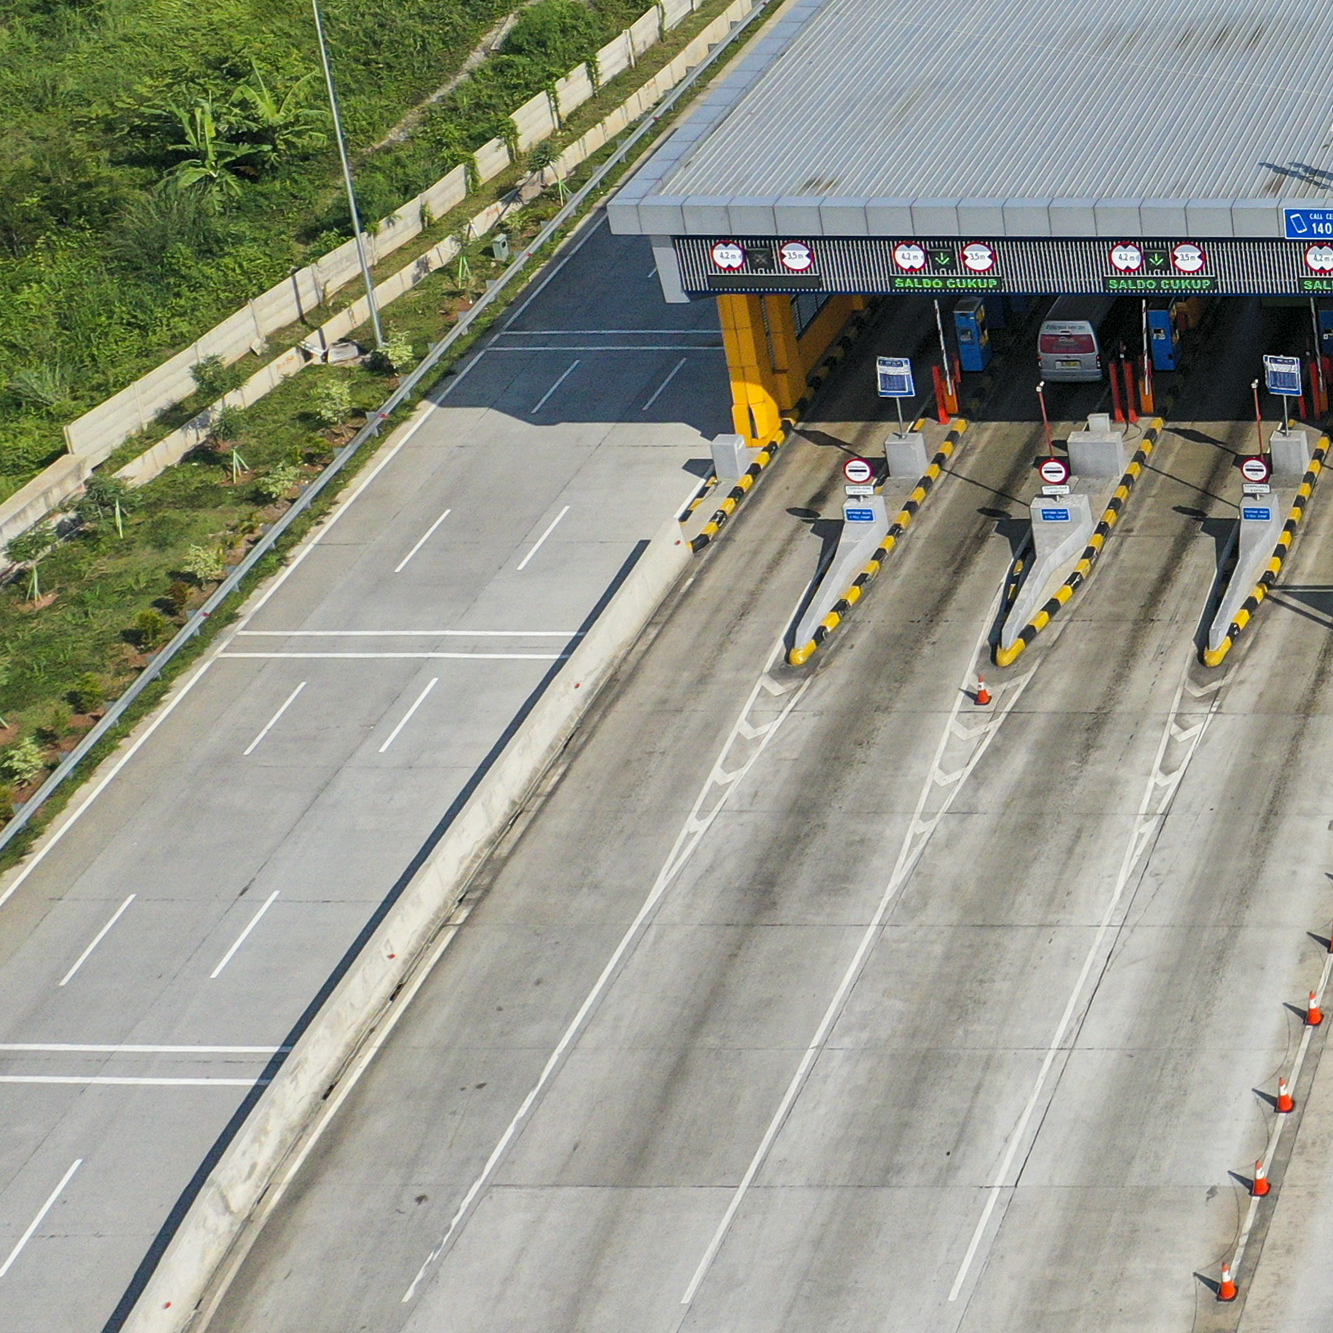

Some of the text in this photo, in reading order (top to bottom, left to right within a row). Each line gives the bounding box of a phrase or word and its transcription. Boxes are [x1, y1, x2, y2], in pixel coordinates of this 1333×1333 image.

[894, 278, 997, 289] SALDO CUKUP
[1108, 279, 1211, 290] SALDO CUKUP
